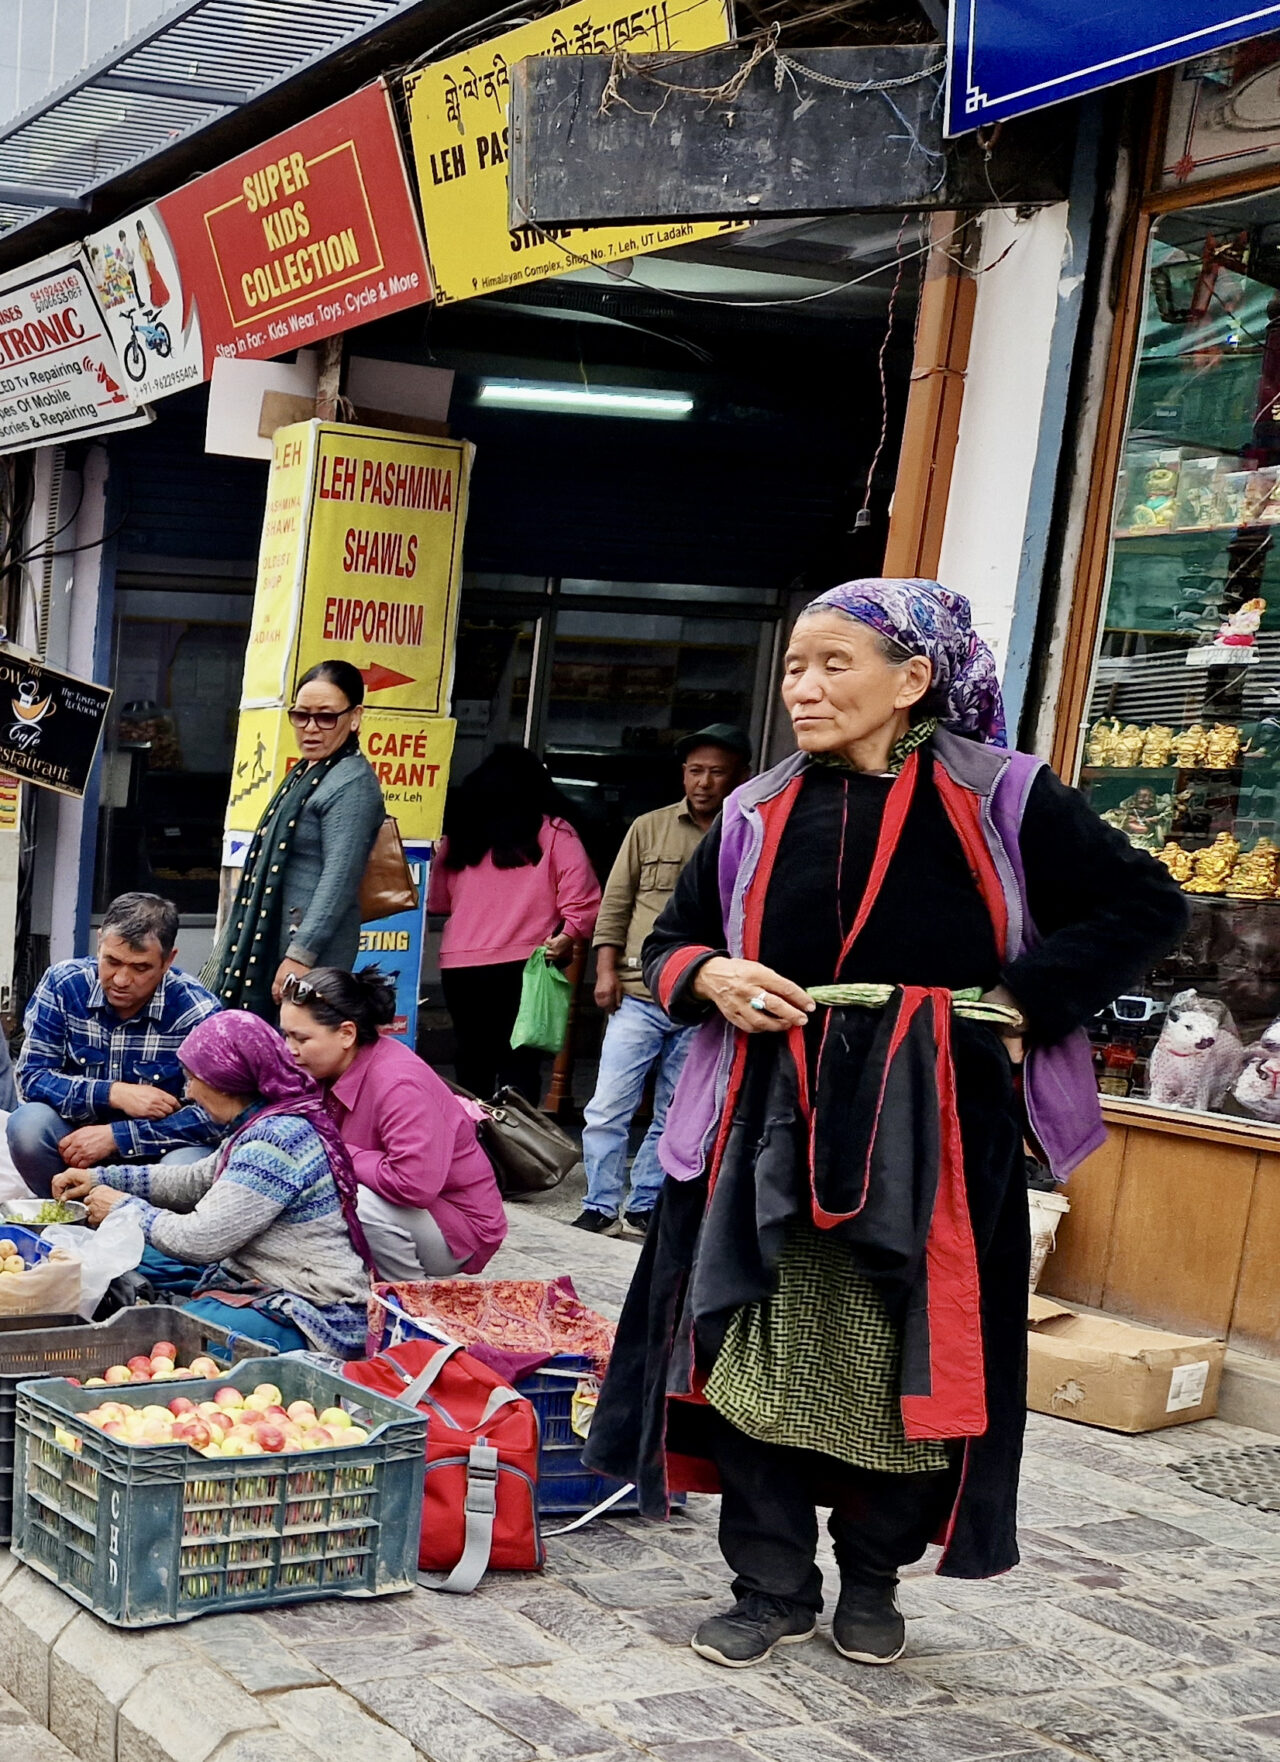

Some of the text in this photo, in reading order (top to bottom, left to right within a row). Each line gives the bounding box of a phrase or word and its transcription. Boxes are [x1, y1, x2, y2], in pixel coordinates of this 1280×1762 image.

[243, 151, 310, 213] SUPER
[430, 144, 466, 186] LEH
[262, 200, 310, 251] KIDS
[241, 228, 360, 308] COLLECTION
[482, 224, 693, 288] Himalayan Complex, Shop No. 7, Leh, UT Ladakh
[216, 340, 236, 358] Step
[237, 334, 246, 352] in
[268, 318, 288, 341] Kids
[288, 310, 318, 334] Wear,
[318, 300, 344, 321] Toys,
[345, 286, 377, 314] Cycle
[379, 283, 388, 299] &
[390, 272, 419, 294] More
[15, 376, 29, 389] Tv
[29, 358, 82, 387] Repairing
[16, 398, 30, 414] Of
[31, 388, 70, 409] Mobile
[30, 413, 41, 428] &
[42, 402, 98, 427] Repairing
[320, 456, 452, 512] LEH PASHMINA
[265, 518, 296, 537] SHAWL
[344, 528, 418, 578] SHAWLS
[254, 629, 280, 644] ADAKH
[323, 596, 424, 646] EMPORIUM
[368, 730, 427, 758] CAFÉ
[404, 792, 422, 802] Leh
